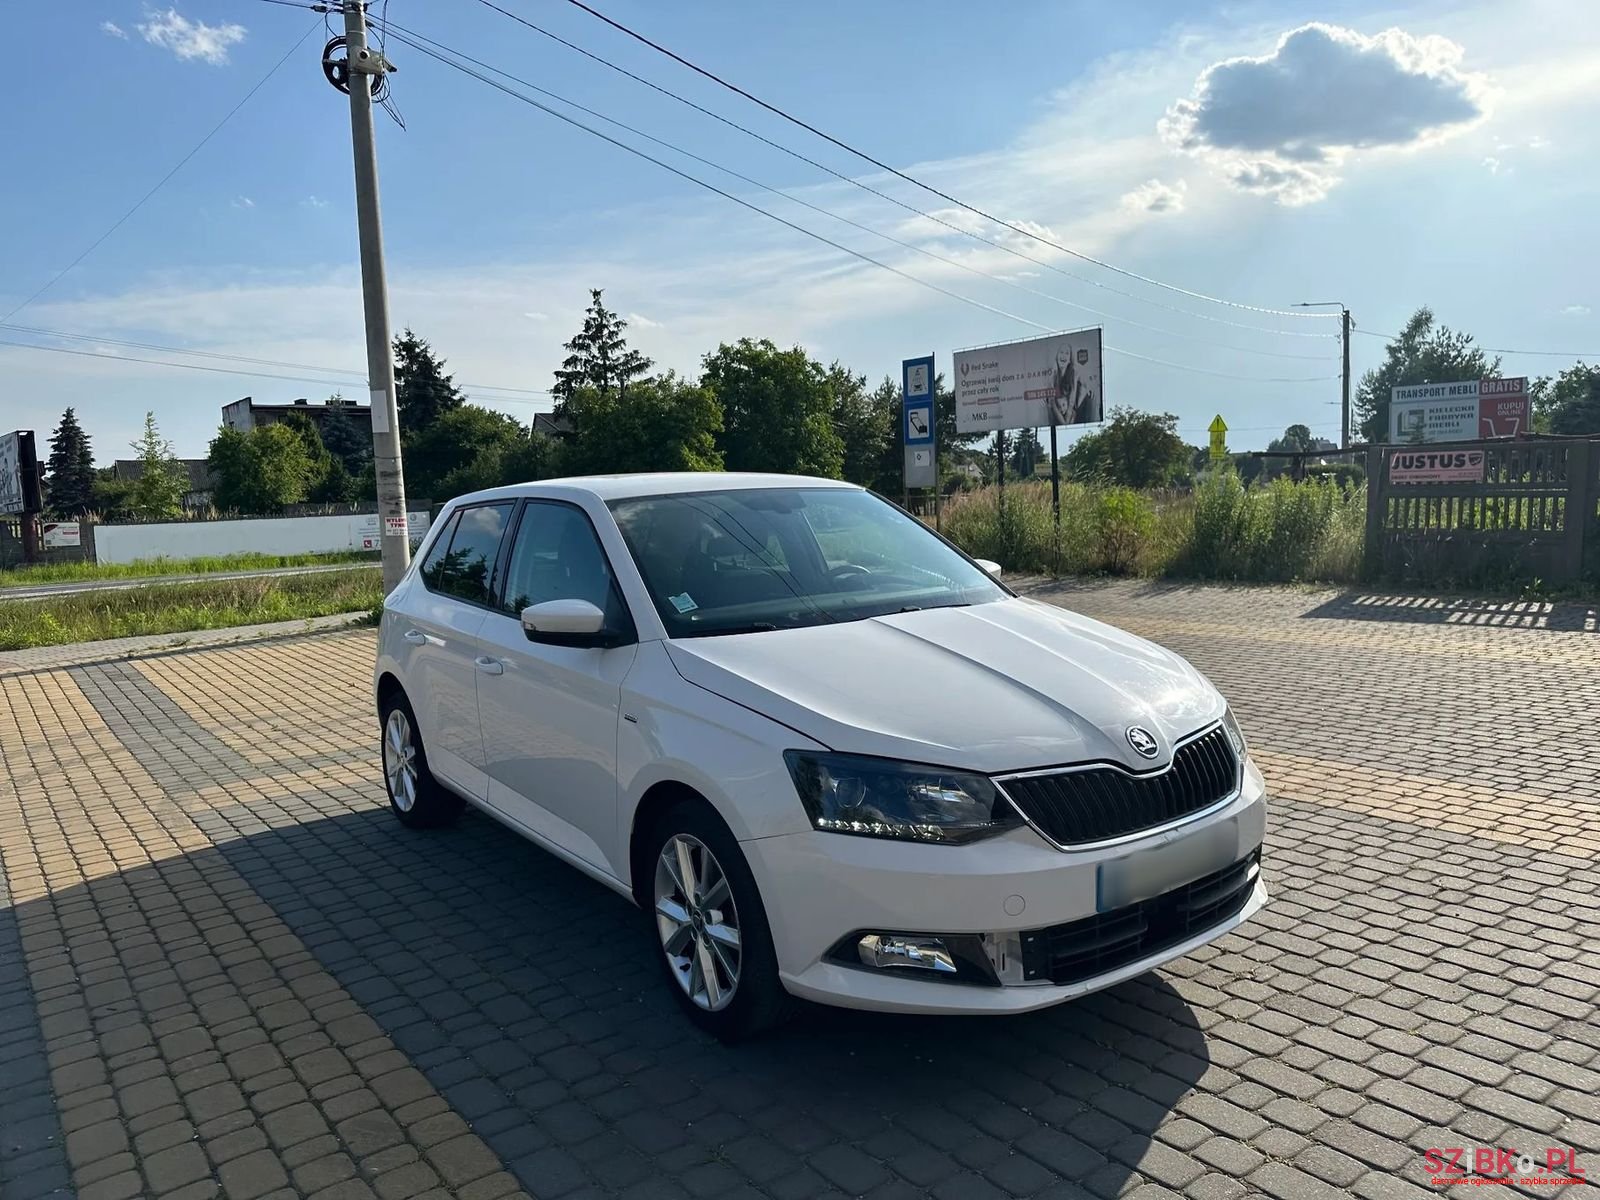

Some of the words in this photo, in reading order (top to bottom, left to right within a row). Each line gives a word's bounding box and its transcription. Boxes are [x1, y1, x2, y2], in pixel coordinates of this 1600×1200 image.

[1001, 374, 1015, 383] dom
[1396, 387, 1446, 400] TRANSPORT
[1449, 384, 1477, 395] MEBLI
[1482, 380, 1520, 394] GRATIS
[1497, 401, 1525, 410] KUPUJ
[972, 412, 988, 421] MKB
[1391, 453, 1467, 469] JUSTUS
